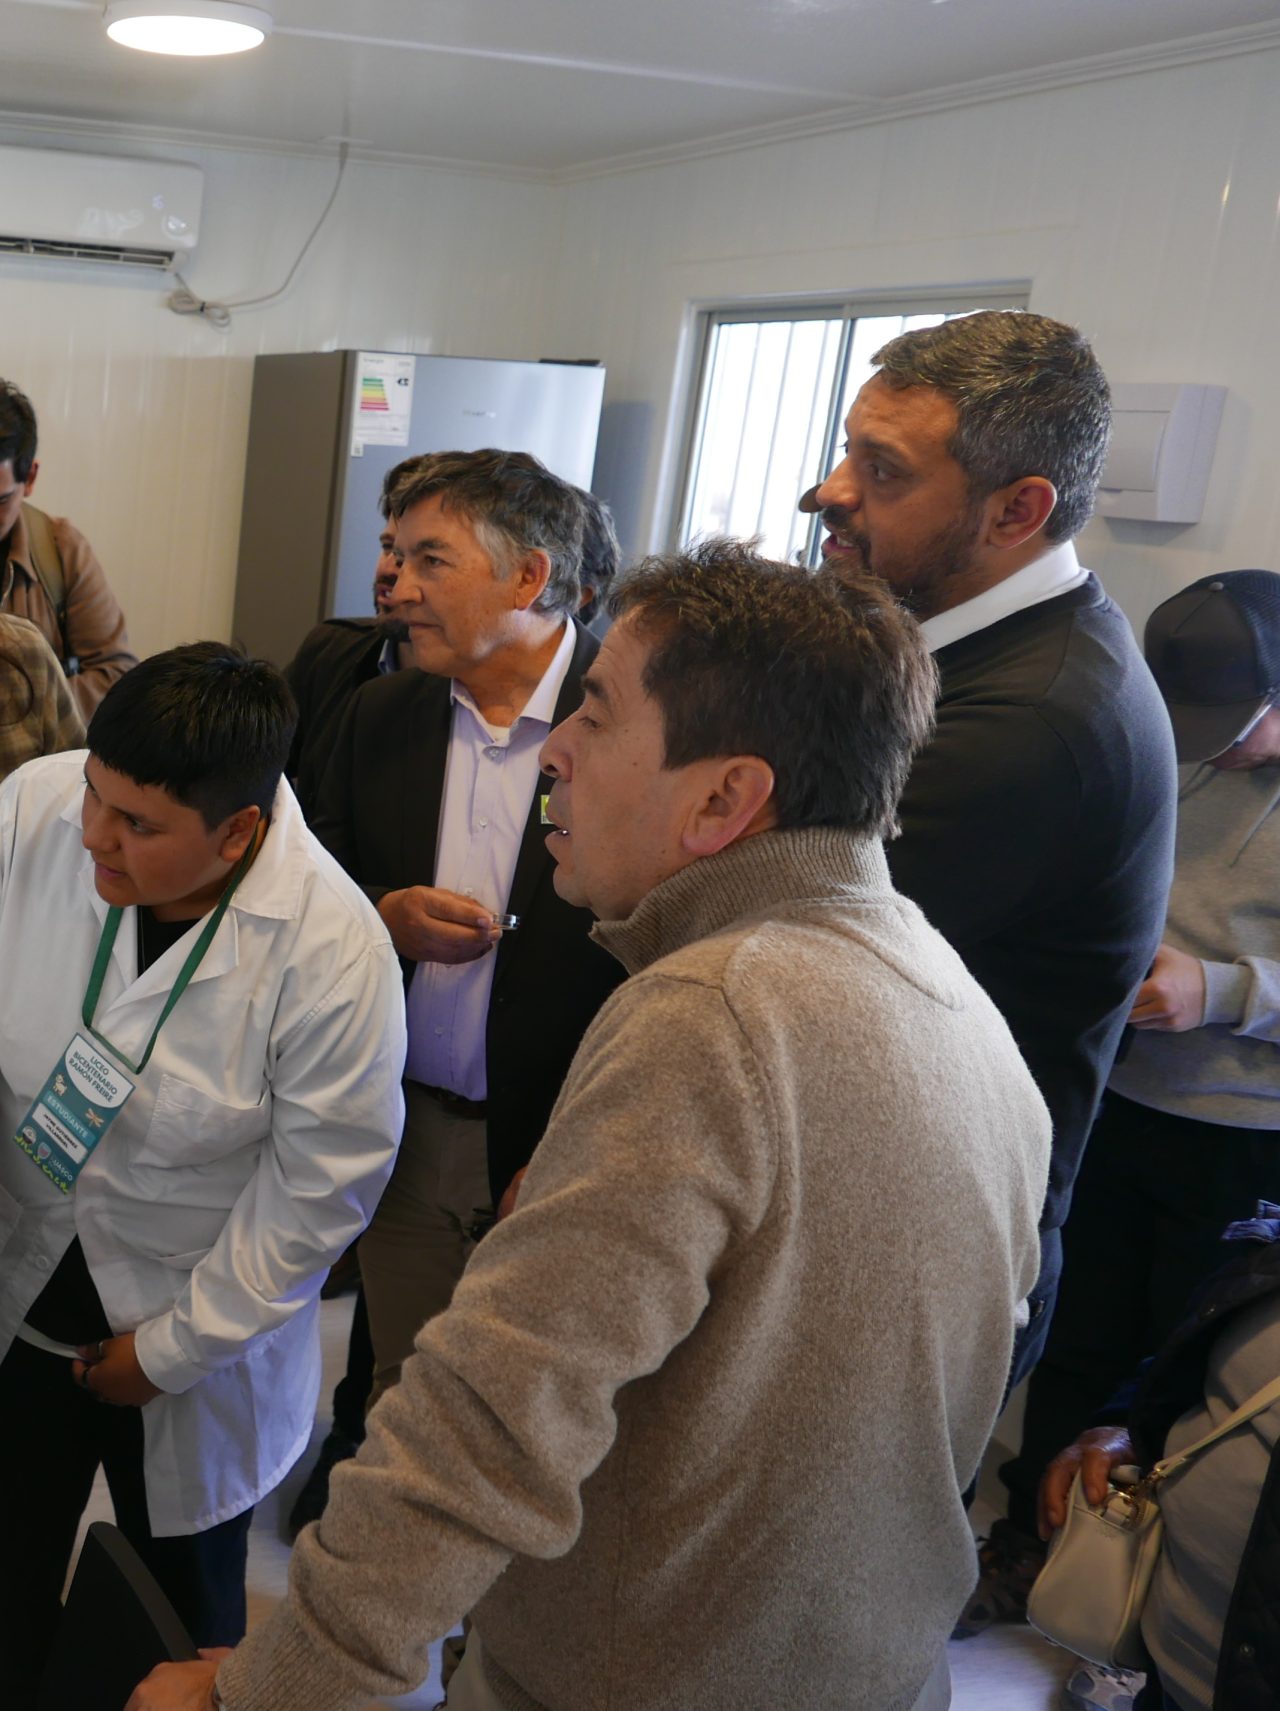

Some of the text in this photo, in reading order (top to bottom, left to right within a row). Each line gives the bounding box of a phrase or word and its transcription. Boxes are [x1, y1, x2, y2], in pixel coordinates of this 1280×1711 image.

[73, 1051, 117, 1095] BICENTENARIO
[90, 1056, 109, 1075] LICEO
[91, 1079, 113, 1103] FREIRE
[46, 1095, 89, 1139] ESTUDIANTE
